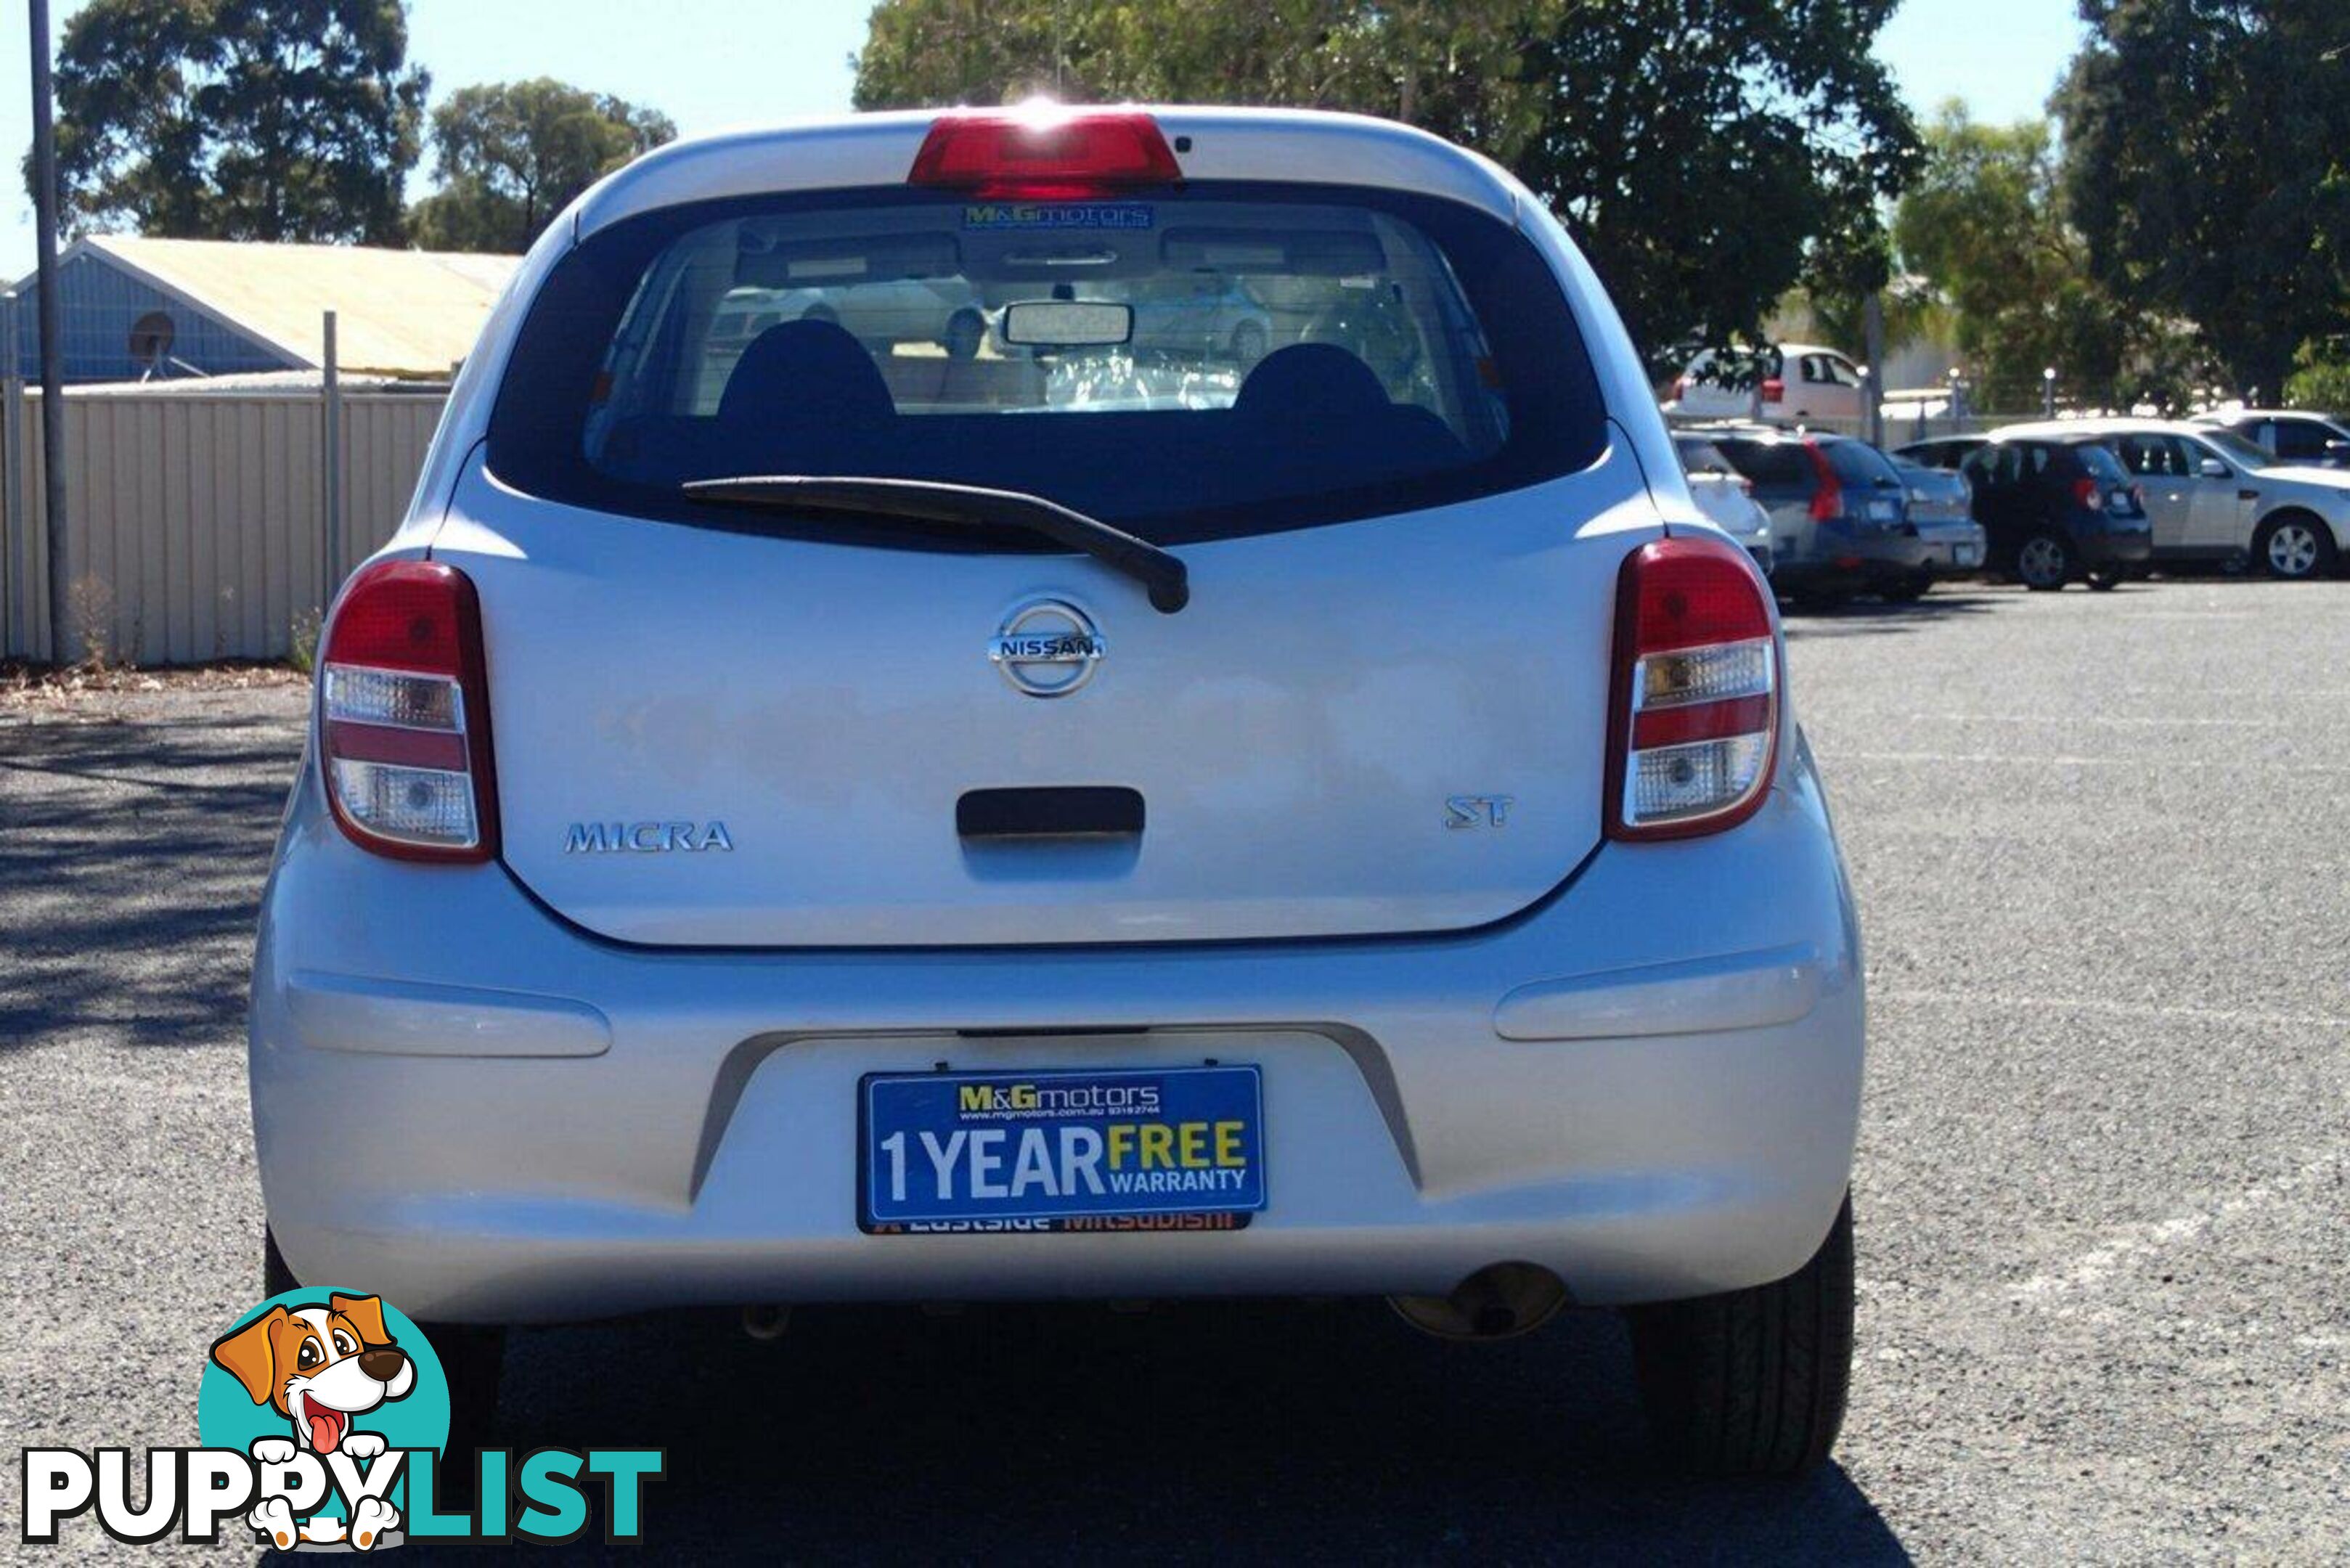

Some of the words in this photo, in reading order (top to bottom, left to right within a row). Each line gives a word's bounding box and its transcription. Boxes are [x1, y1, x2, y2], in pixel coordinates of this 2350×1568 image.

[1000, 637, 1094, 656] NISSAN
[1445, 796, 1514, 829] ST
[565, 821, 734, 853] MICRA
[960, 1085, 1160, 1111] M&Gmotors
[960, 1106, 1104, 1121] www.mgmotors.com.au
[881, 1130, 906, 1202] 1
[918, 1125, 1108, 1200] YEAR
[1108, 1121, 1247, 1171] FREE
[1109, 1169, 1247, 1196] WARRANTY
